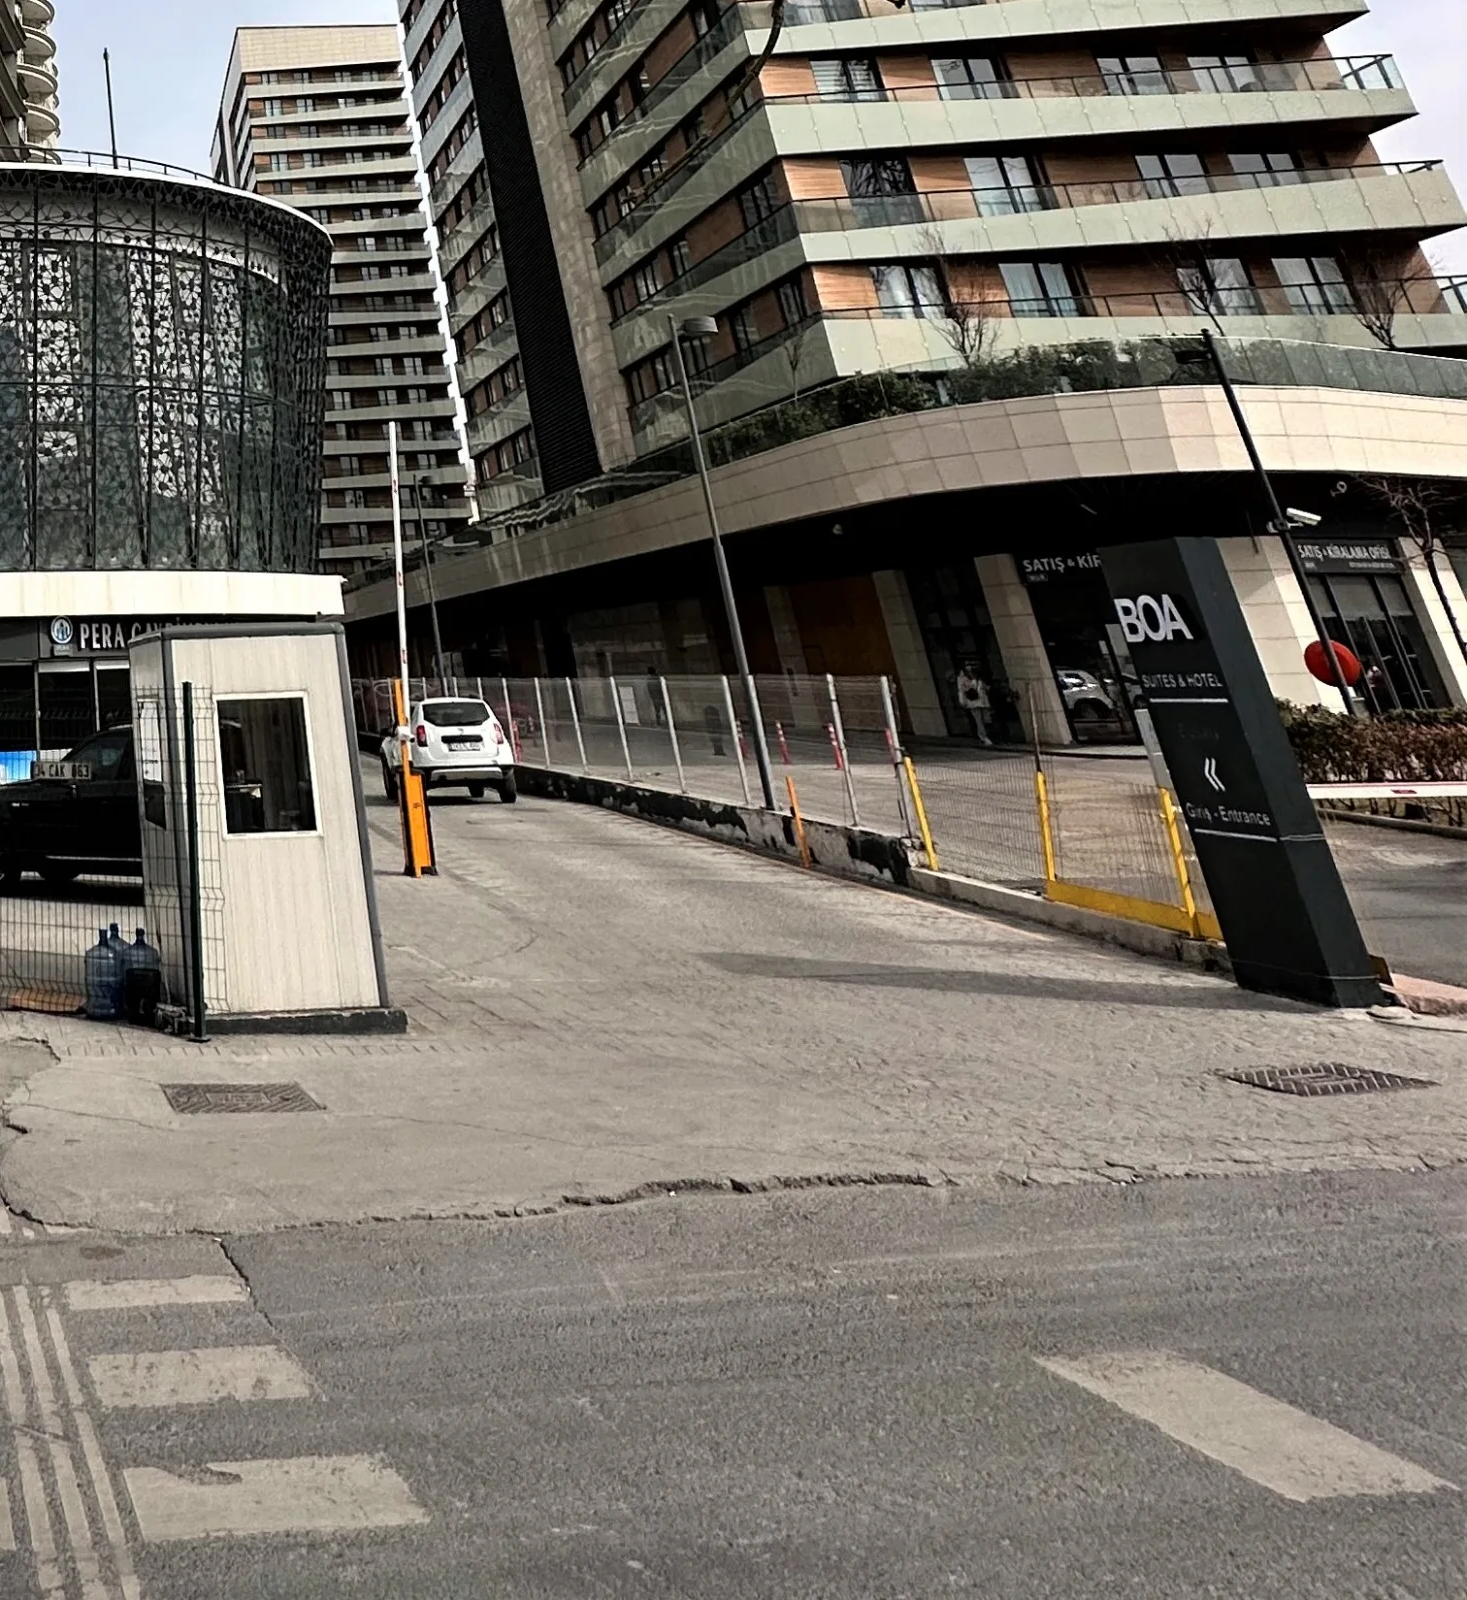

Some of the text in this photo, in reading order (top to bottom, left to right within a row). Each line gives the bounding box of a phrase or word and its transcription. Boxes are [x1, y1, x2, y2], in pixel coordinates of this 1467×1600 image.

[1023, 557, 1065, 573] SATIŞ
[1114, 594, 1194, 642] BOA
[80, 623, 125, 649] PERA
[1142, 674, 1177, 688] SUITES
[1187, 673, 1223, 688] HOTEL
[1186, 802, 1213, 823] Giriş
[1219, 806, 1271, 826] Entrance
